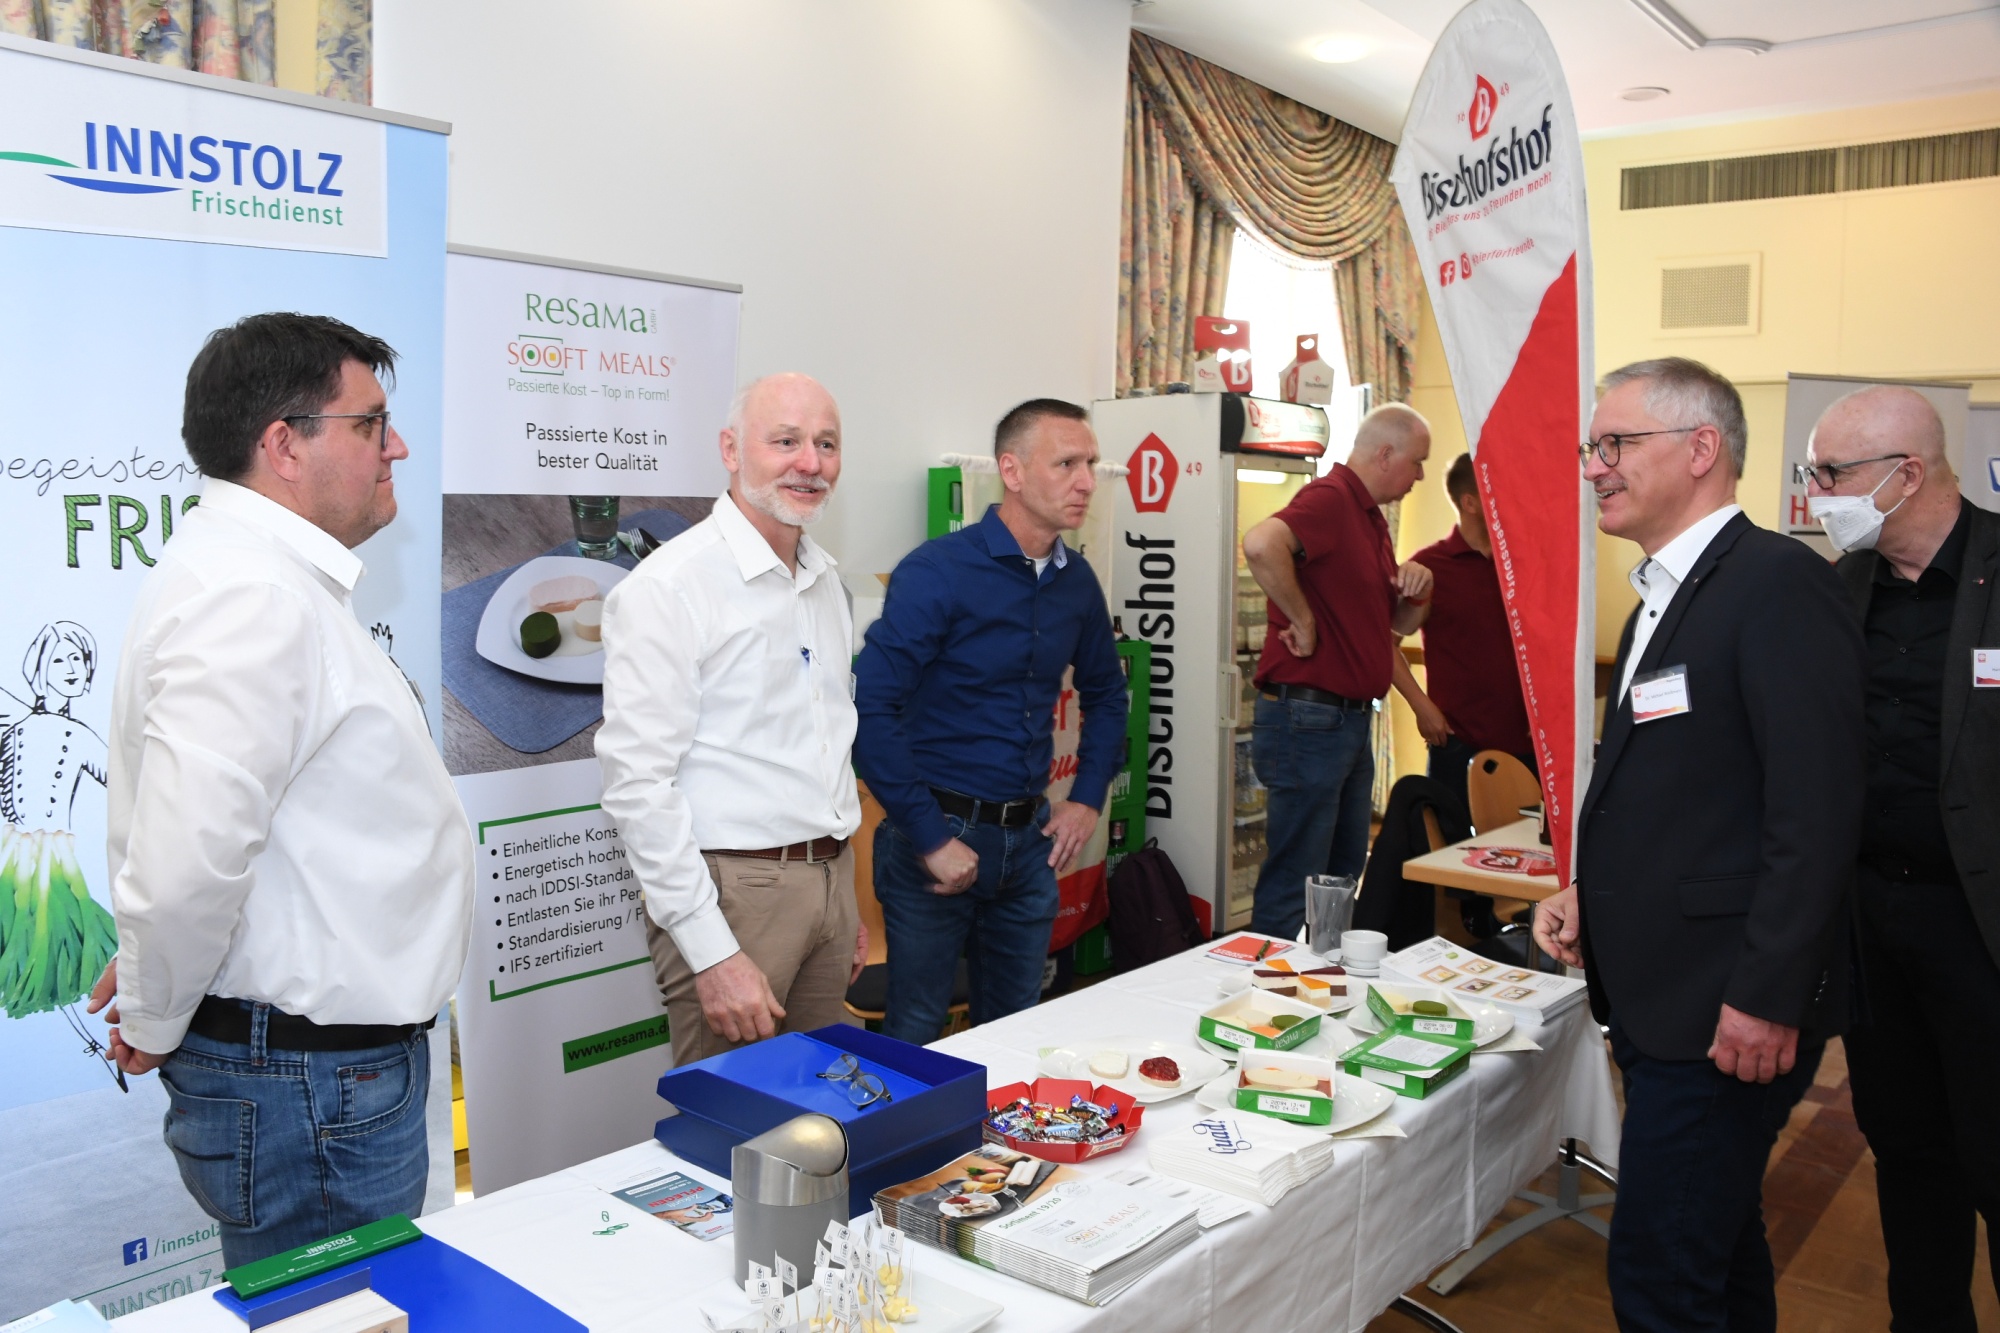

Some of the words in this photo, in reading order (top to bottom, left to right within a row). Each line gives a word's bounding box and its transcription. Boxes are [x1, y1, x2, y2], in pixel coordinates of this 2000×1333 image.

[85, 121, 344, 197] INNSTOLZ
[1420, 102, 1553, 221] Bischofshof
[1527, 171, 1552, 194] macht
[192, 189, 344, 226] Frischdienst
[507, 341, 589, 371] SOOFT
[507, 377, 560, 395] Passierte
[563, 381, 588, 397] Kost
[602, 384, 622, 402] Top
[624, 385, 635, 400] in
[638, 386, 670, 402] Form!
[613, 427, 649, 446] Kost
[653, 429, 668, 446] in
[0, 446, 202, 497] egeister
[537, 449, 590, 469] bester
[595, 451, 659, 471] Qualität
[1140, 449, 1166, 504] B
[63, 494, 202, 570] FRI
[503, 831, 581, 858] Einheitliche
[504, 855, 585, 882] Energetisch
[506, 887, 538, 905] nach
[507, 903, 570, 928] Entlasten
[574, 897, 595, 913] Sie
[599, 892, 616, 908] ihr
[508, 914, 623, 951] Standardisierung
[510, 955, 532, 974] IFS
[534, 940, 604, 968] zertifiziert
[998, 1208, 1041, 1230] Sortiment
[1036, 1195, 1062, 1214] 19/20
[306, 1234, 355, 1256] INNSTOLZ
